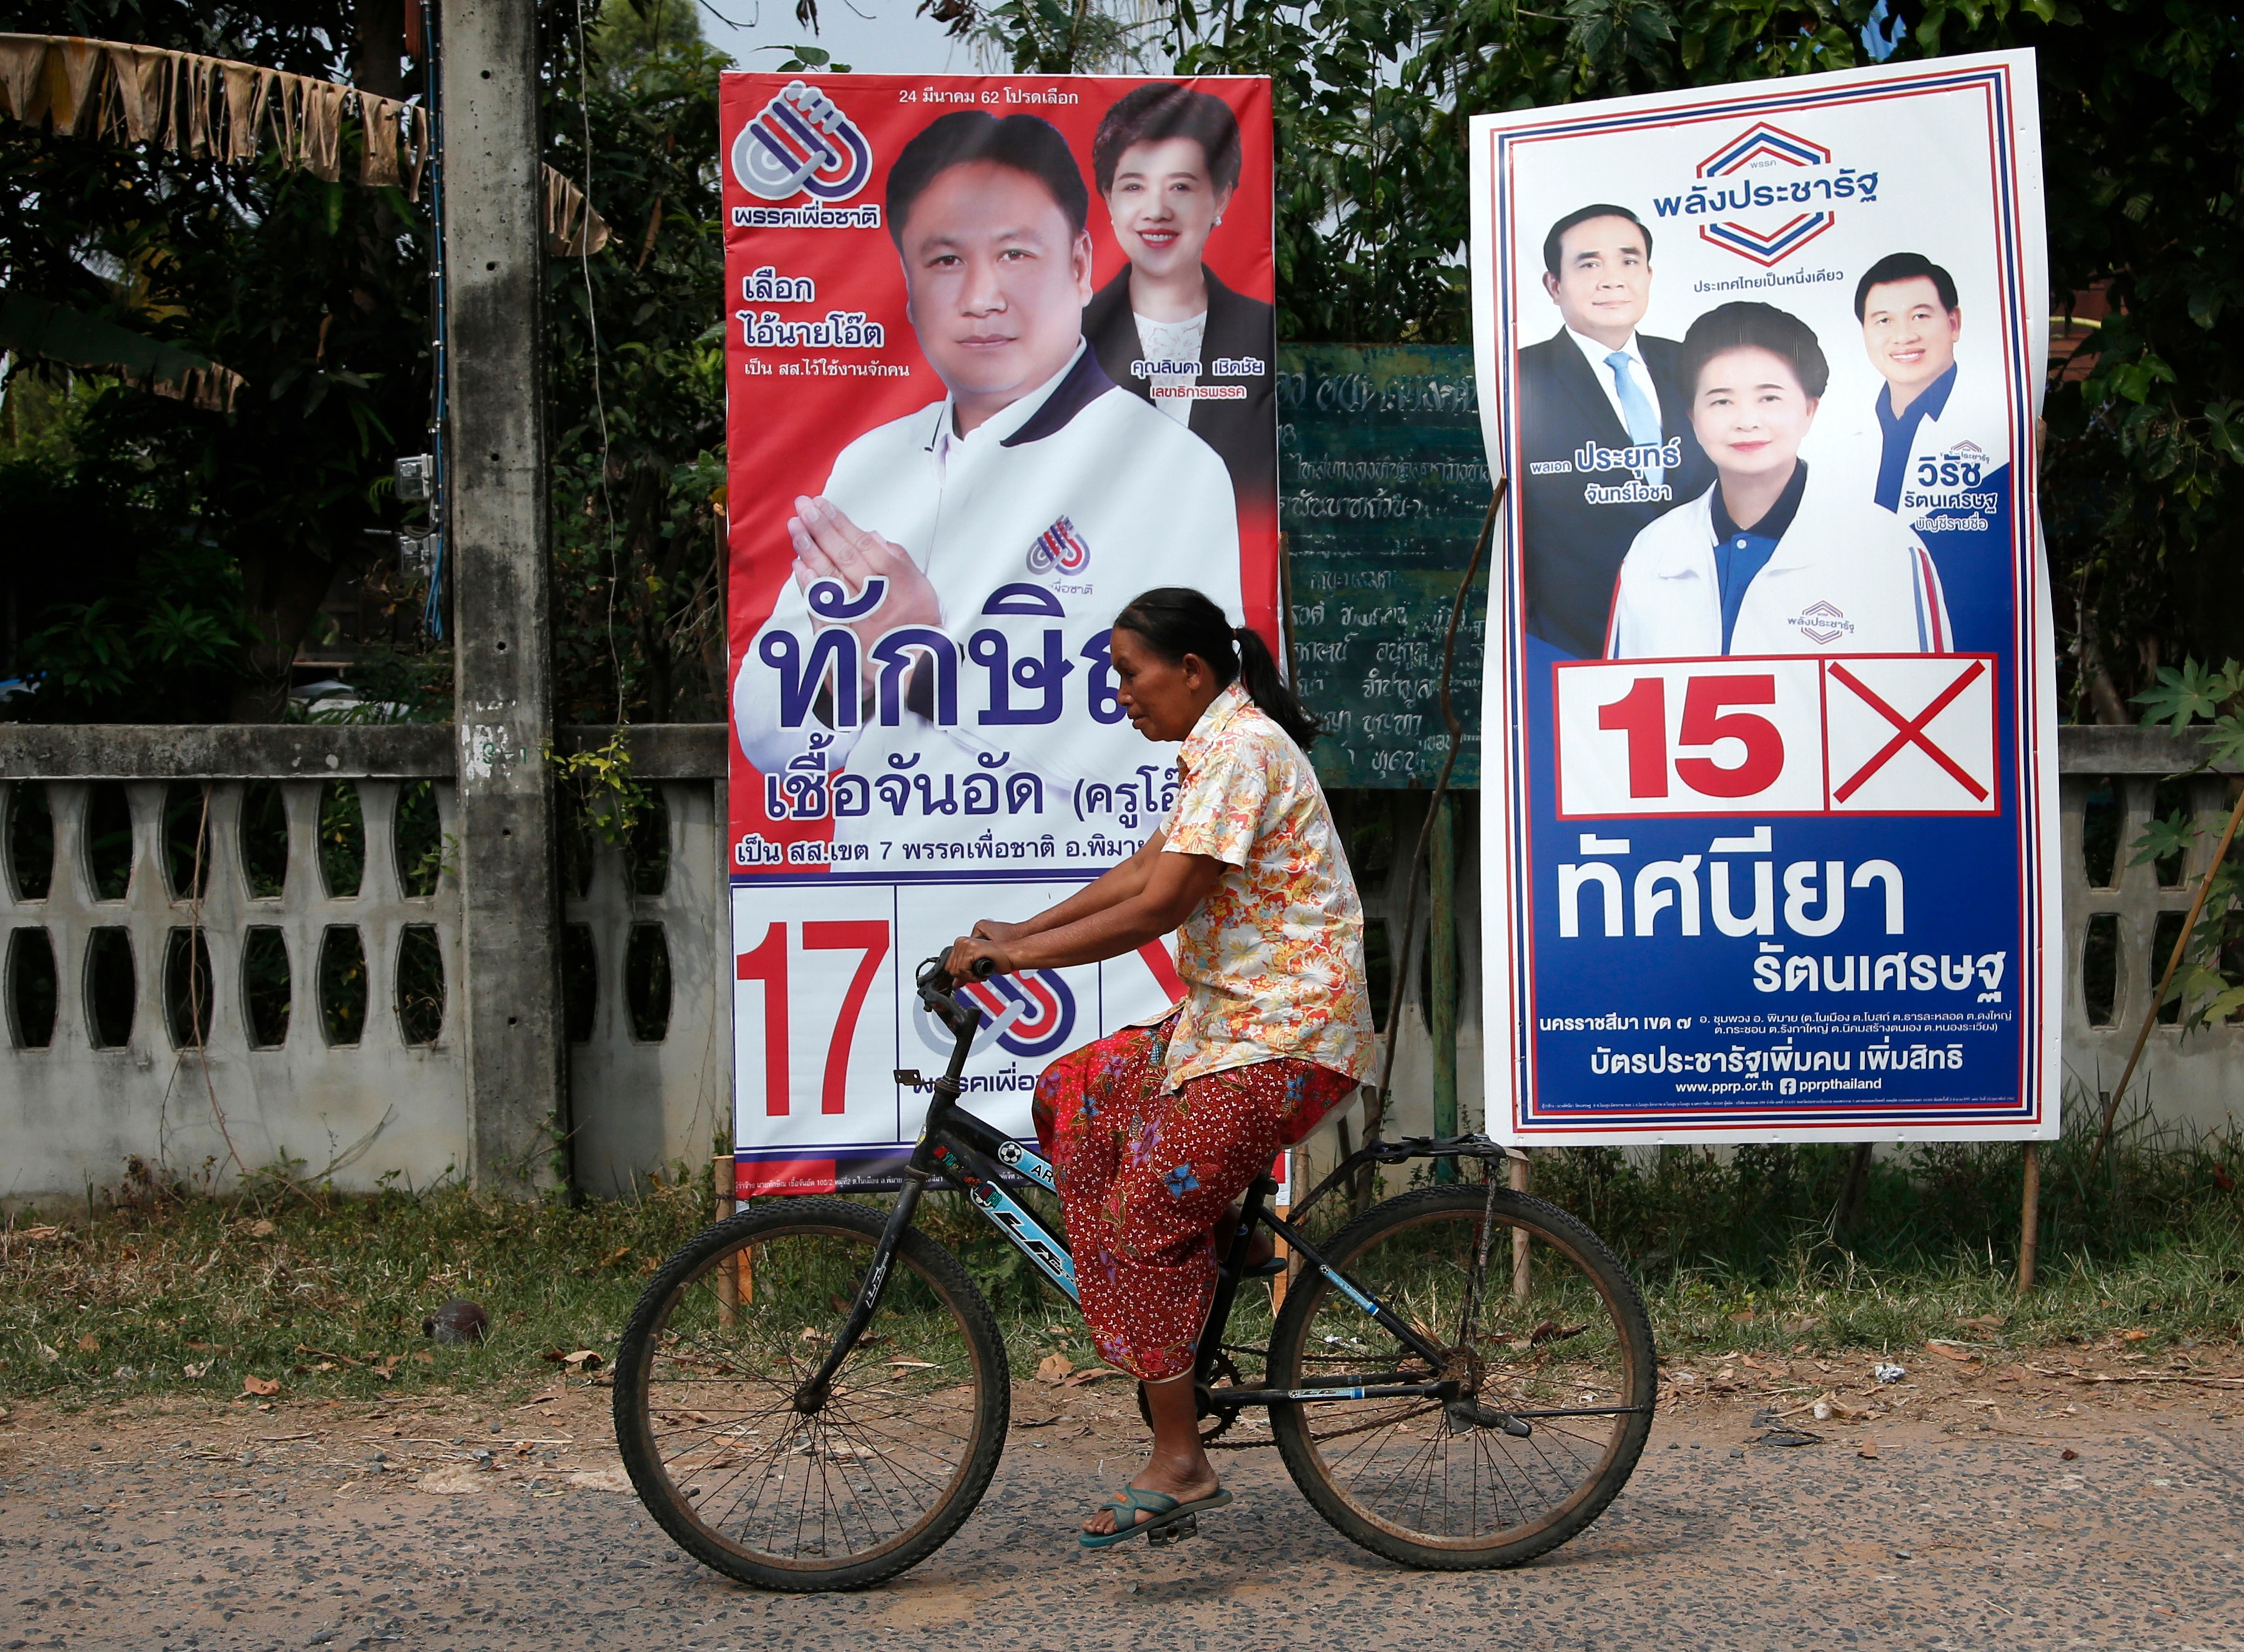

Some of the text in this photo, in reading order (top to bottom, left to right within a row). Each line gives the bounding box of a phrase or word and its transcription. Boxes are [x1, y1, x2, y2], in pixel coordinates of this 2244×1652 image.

[899, 87, 1079, 105] 24 มีนาคม 62 โปรดเลือก
[1750, 159, 1777, 169] พรรค
[1653, 168, 1878, 217] พลังประชารัฐ
[733, 200, 879, 227] พรรคเพื่อชาติ
[745, 268, 812, 300] เลือก
[1693, 267, 1844, 293] ประเทศไทยเป็นหนึ่งเดียว
[739, 313, 881, 346] ไอ้นายโอ๊ต
[744, 358, 910, 376] เป็น สส.ไว้ใช้งานจักคน
[1133, 358, 1263, 378] คุณลินดา เชิดชัย
[1152, 385, 1245, 398] เลขาธิการพรรค
[1531, 438, 1680, 478] พลเอก ประยุทธ์
[1917, 454, 1981, 487] วิรัช
[1586, 482, 1671, 503] จันทร์โอชา
[1904, 491, 1998, 514] รัตนเศรษฐ
[1916, 512, 1987, 531] บัญชีรายชื่อ
[1597, 674, 1785, 799] 15
[767, 732, 1180, 829] เชื้อจันอัด (ครูโอ๊
[737, 835, 780, 863] เป็น
[790, 841, 869, 862] สส.เขต
[879, 841, 893, 860] 7
[902, 828, 1055, 860] พรรคเพื่อชาติ
[1557, 825, 1906, 939] ทัศนียา
[1752, 941, 2007, 1004] รัตนเศรษฐ
[737, 920, 889, 1118] 17
[1539, 1010, 2012, 1031] นครราชสีมา เขต ๗ อ. ชุมพวง อ. พิมาย (ต.ในเมือง ต.โบสถ์ ต.ธารละหลอด ต.ดงใหญ่
[1714, 1022, 1998, 1035] ต.กระชอน ต.รังกาใหญ่ ต.นิคมสร้างตนเอง ต.หนองระเวียง)
[1590, 1035, 1964, 1078] บัตรประชารัฐเพิ่มคน เพิ่มสิทธิ
[913, 1061, 1039, 1094] พรคเพื่อ
[1675, 1077, 1882, 1095] www.pprp.or.th pprpthailand
